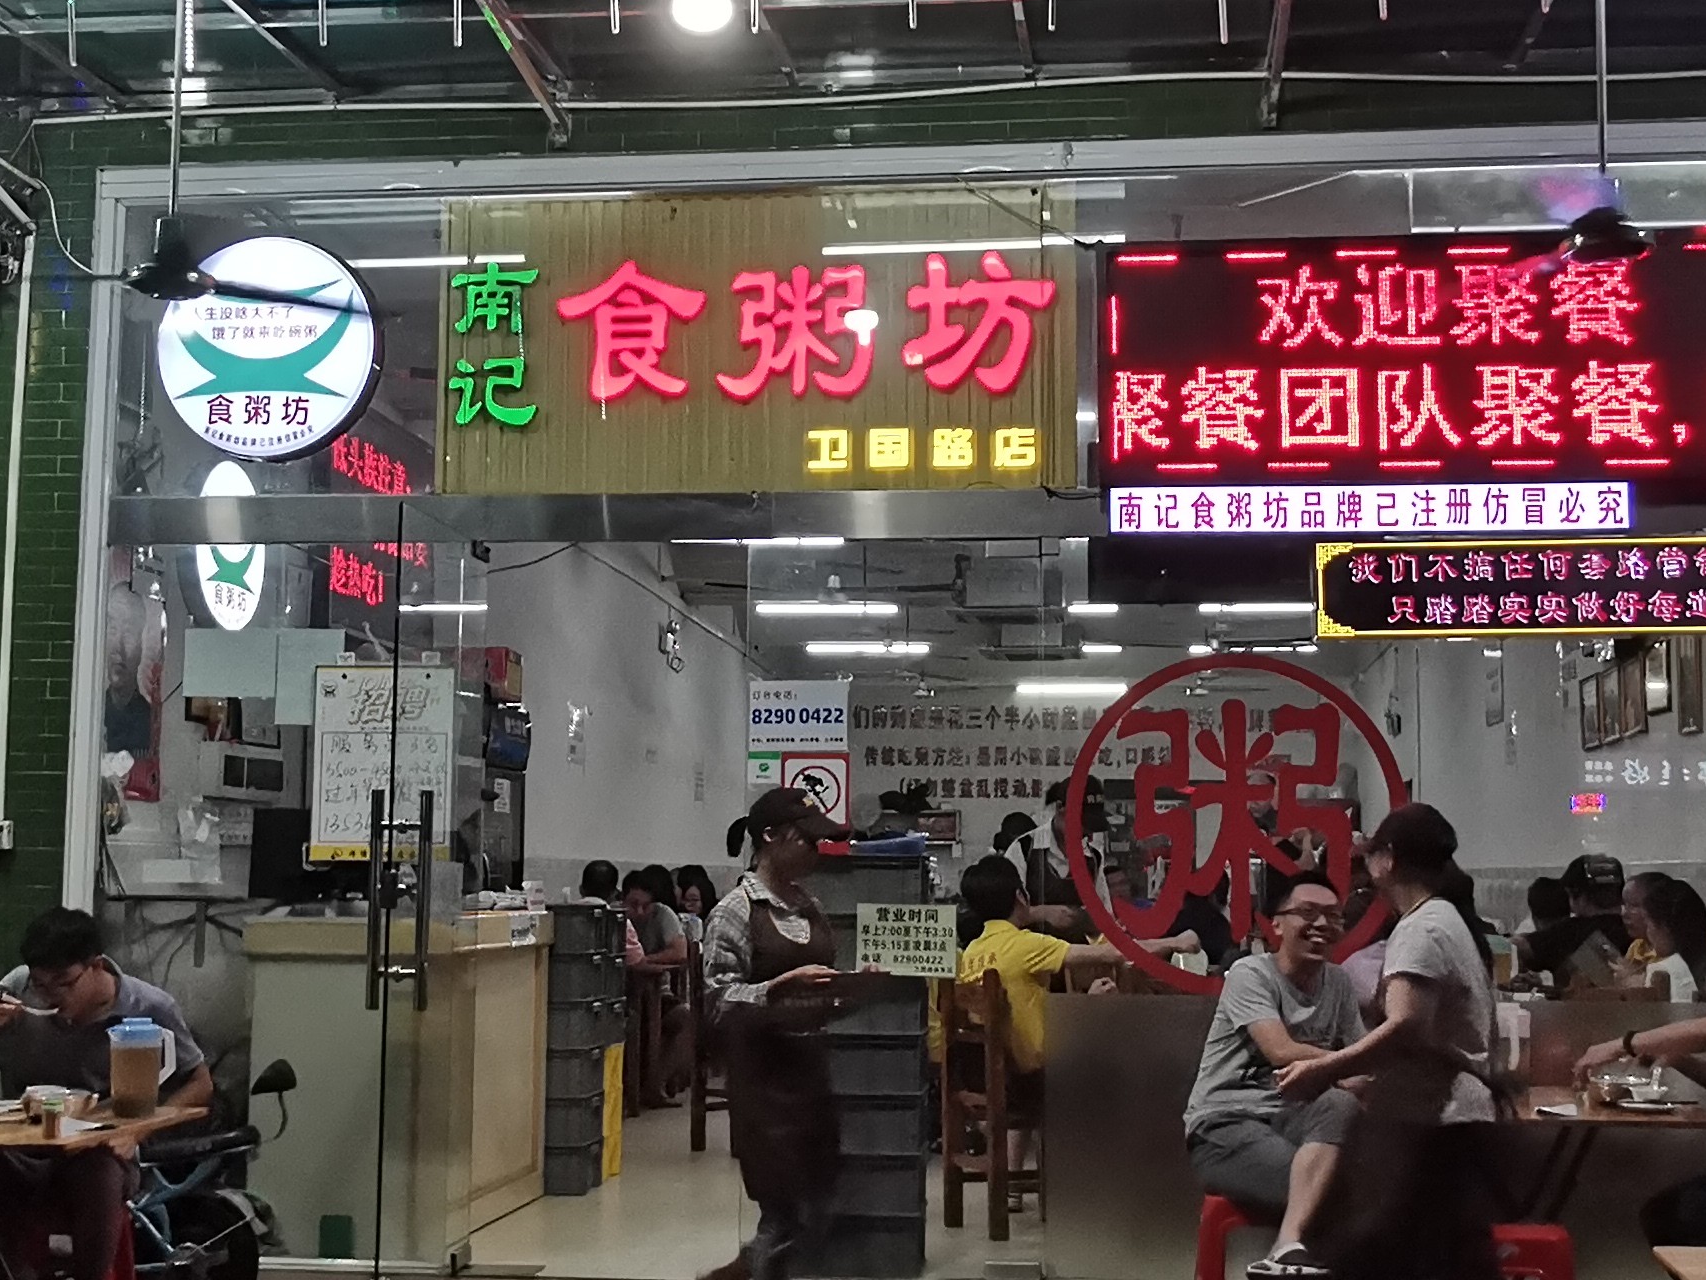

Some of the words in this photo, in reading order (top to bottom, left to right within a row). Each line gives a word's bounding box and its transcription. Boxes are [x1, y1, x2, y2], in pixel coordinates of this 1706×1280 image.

[556, 250, 1057, 402] 食粥坊
[1256, 262, 1640, 348] 欢迎聚餐
[449, 262, 540, 427] 南记
[206, 394, 310, 426] 食粥坊
[807, 427, 1036, 470] 卫国路店
[1117, 486, 1624, 529] 南记食粥坊品牌已注册仿冒必究
[751, 707, 795, 726] 8290
[798, 707, 845, 725] 0422
[1113, 697, 1356, 948] 粥
[875, 906, 939, 924] 营业时间
